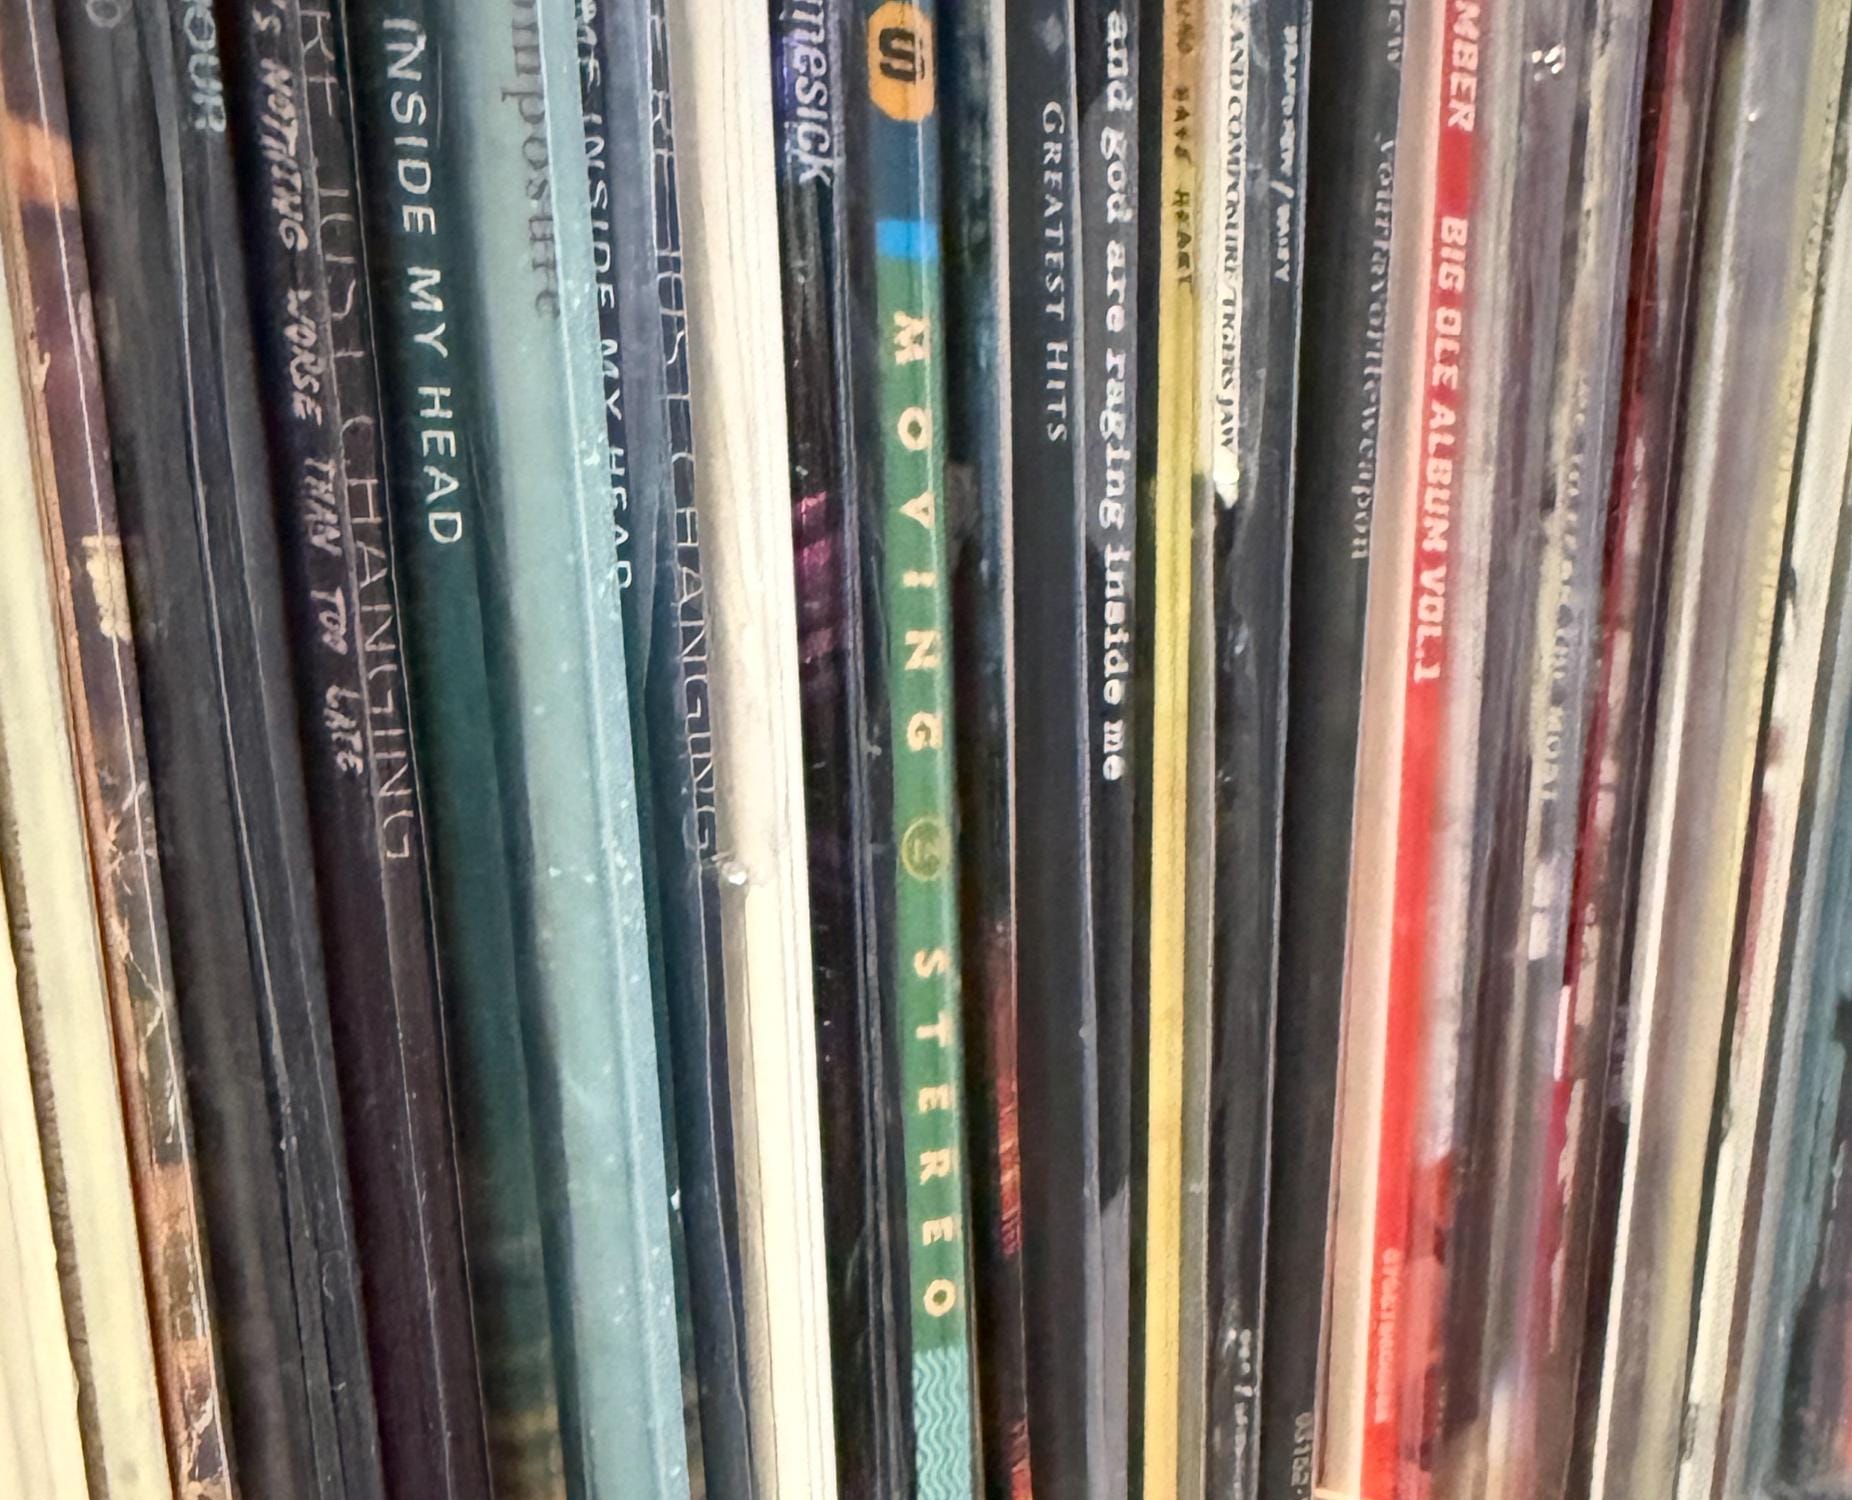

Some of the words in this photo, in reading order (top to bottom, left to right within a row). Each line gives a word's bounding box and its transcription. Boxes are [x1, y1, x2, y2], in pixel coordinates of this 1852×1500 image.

[182, 0, 228, 133] OUR
[1106, 9, 1133, 112] and
[1448, 0, 1480, 133] MBER
[260, 57, 309, 252] NOTHING
[382, 17, 438, 236] INSIDE
[501, 0, 562, 321] mposure
[1100, 127, 1134, 224] god
[1042, 100, 1067, 322] GREATEST
[1437, 217, 1468, 292] BIG
[408, 266, 450, 359] MY
[1105, 239, 1129, 333] are
[1430, 306, 1464, 388] OLE
[288, 287, 331, 427] WORSE
[1045, 342, 1070, 443] HITS
[417, 386, 464, 546] HEAD
[1098, 347, 1130, 531] raging
[1216, 394, 1235, 448] JAW
[1420, 400, 1458, 553] ALBUM
[302, 456, 345, 556] THAN
[893, 311, 944, 755] MOVING
[309, 587, 350, 656] TOO
[1103, 540, 1132, 708] inside
[1413, 565, 1448, 684] VOL.1
[325, 686, 365, 776] LATE
[1101, 716, 1126, 783] me
[912, 947, 959, 1320] STEREO
